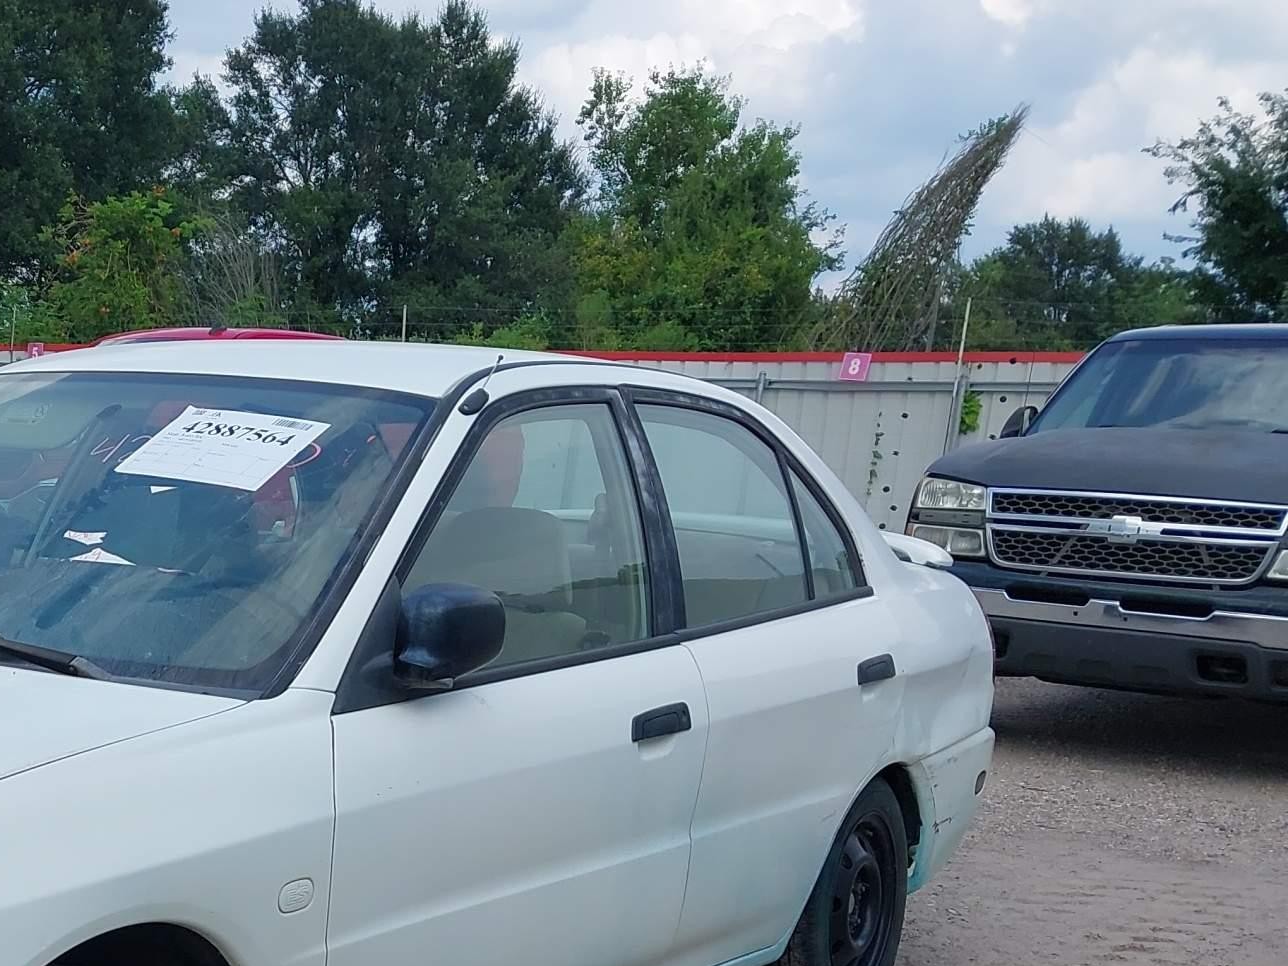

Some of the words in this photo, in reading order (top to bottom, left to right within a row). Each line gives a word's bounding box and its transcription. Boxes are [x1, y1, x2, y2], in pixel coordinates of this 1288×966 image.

[32, 346, 39, 358] 5
[848, 358, 861, 375] 8
[182, 421, 297, 446] 42887564
